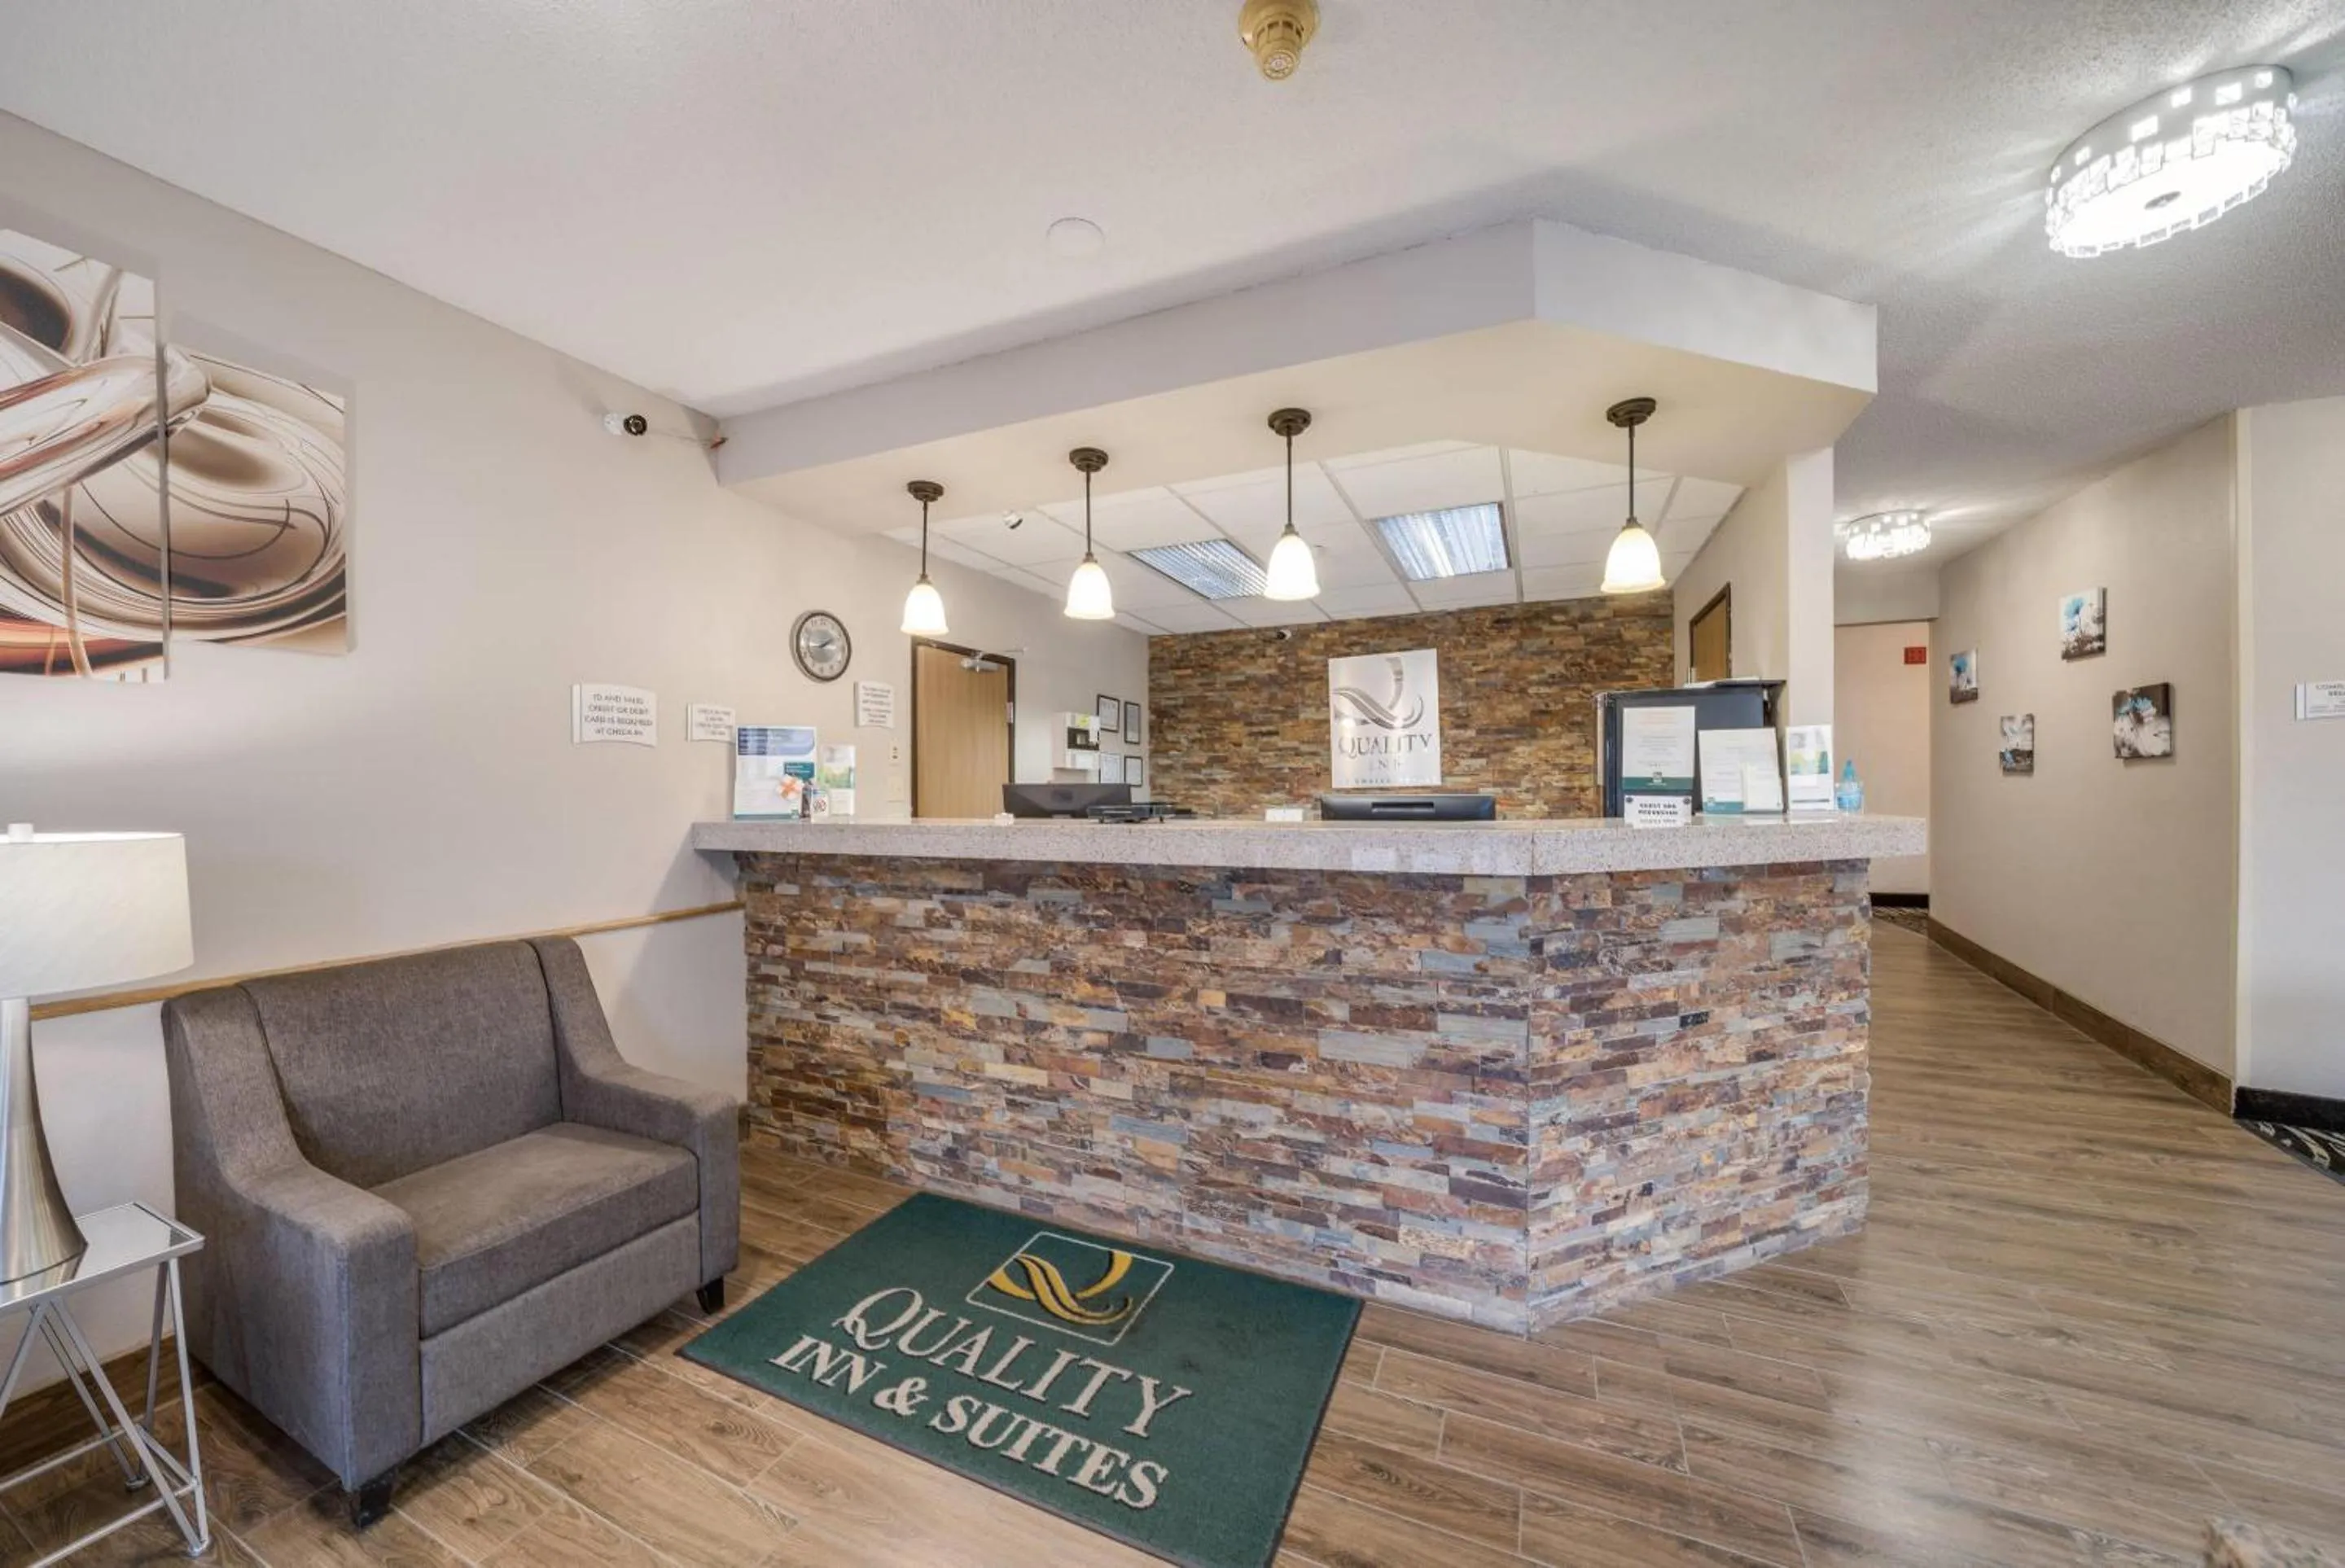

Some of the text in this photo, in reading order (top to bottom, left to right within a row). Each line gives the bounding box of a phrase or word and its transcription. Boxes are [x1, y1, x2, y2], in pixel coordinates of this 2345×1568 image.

[1338, 733, 1433, 759] QUALITY
[768, 1334, 1169, 1510] INN & SUITES
[831, 1287, 1193, 1439] QUALITY
